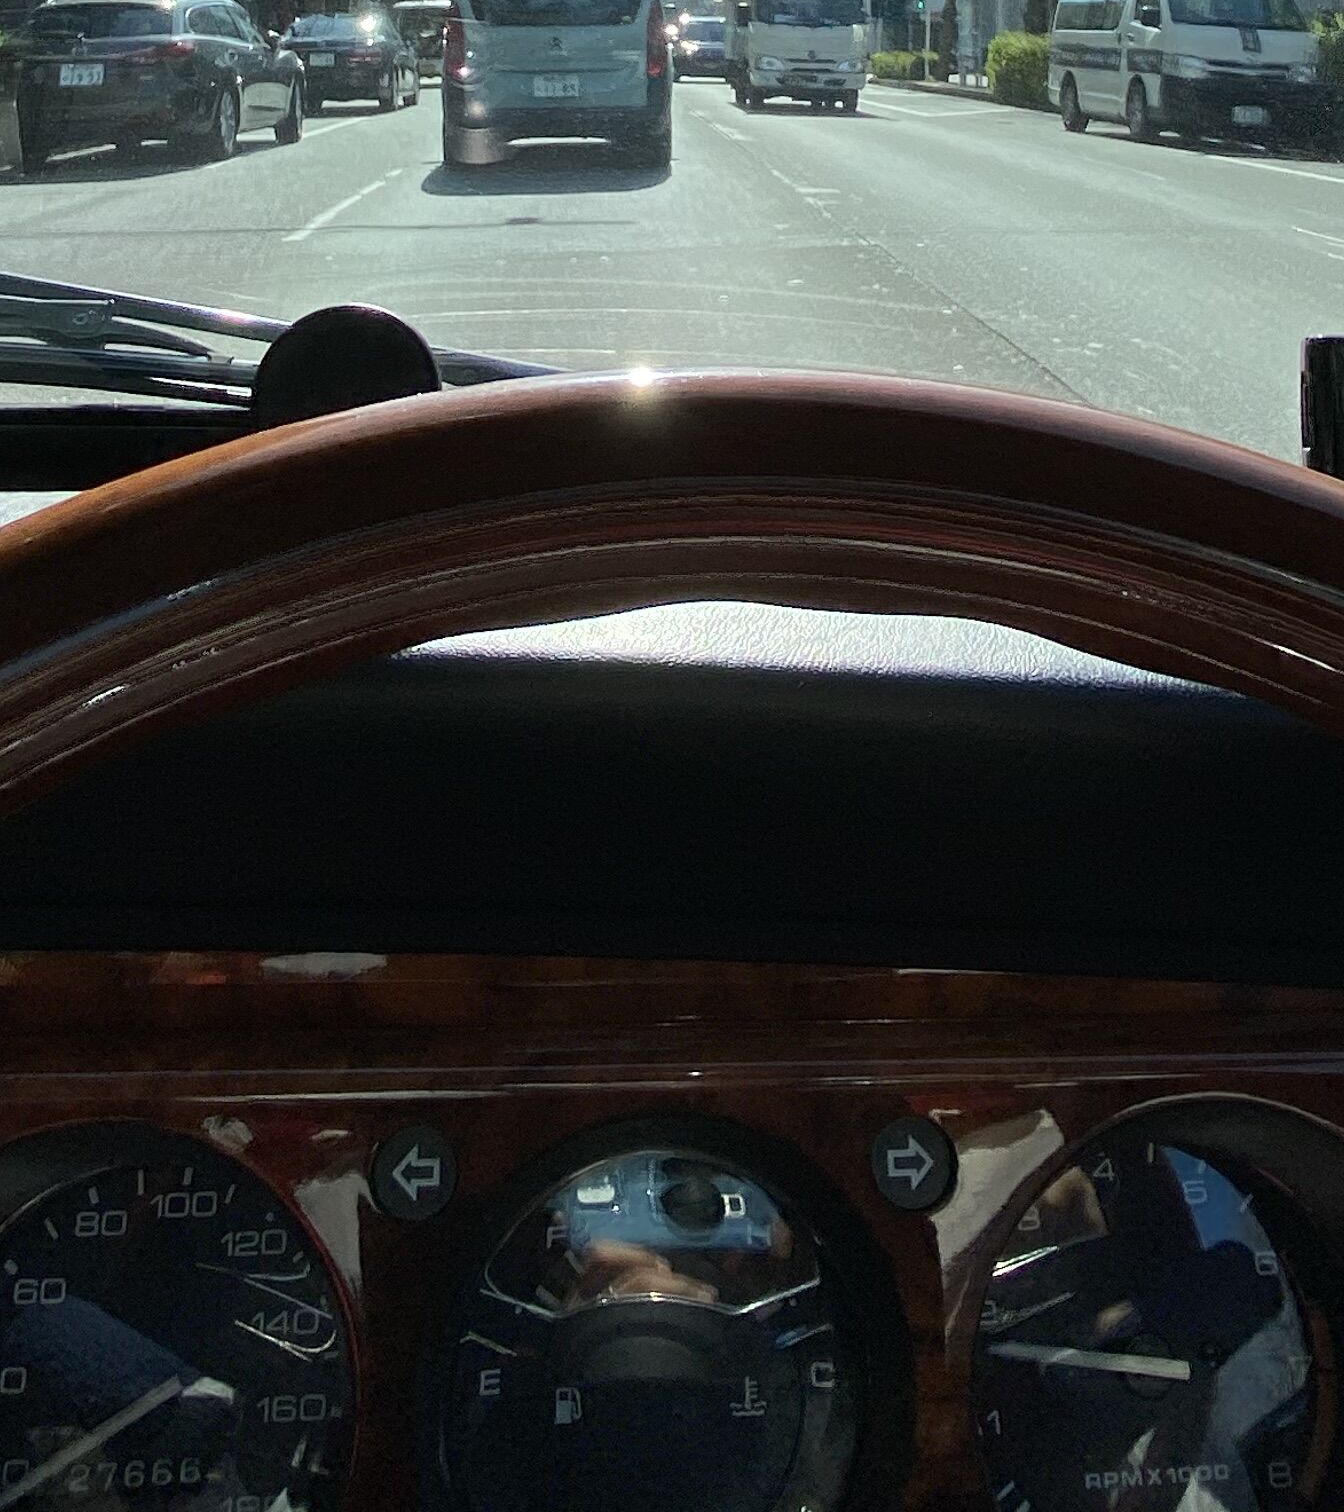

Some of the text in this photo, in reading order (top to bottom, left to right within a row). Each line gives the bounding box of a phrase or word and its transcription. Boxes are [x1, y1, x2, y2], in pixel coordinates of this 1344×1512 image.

[1093, 1158, 1116, 1182] 4
[150, 1190, 218, 1219] 100
[1183, 1178, 1207, 1206] 5
[76, 1210, 128, 1238] 80
[220, 1228, 288, 1257] 120
[1254, 1250, 1279, 1277] 6
[13, 1277, 67, 1306] 60
[250, 1308, 320, 1337] 140
[478, 1368, 501, 1397] E
[256, 1393, 327, 1424] 160
[986, 1409, 1002, 1436] 1
